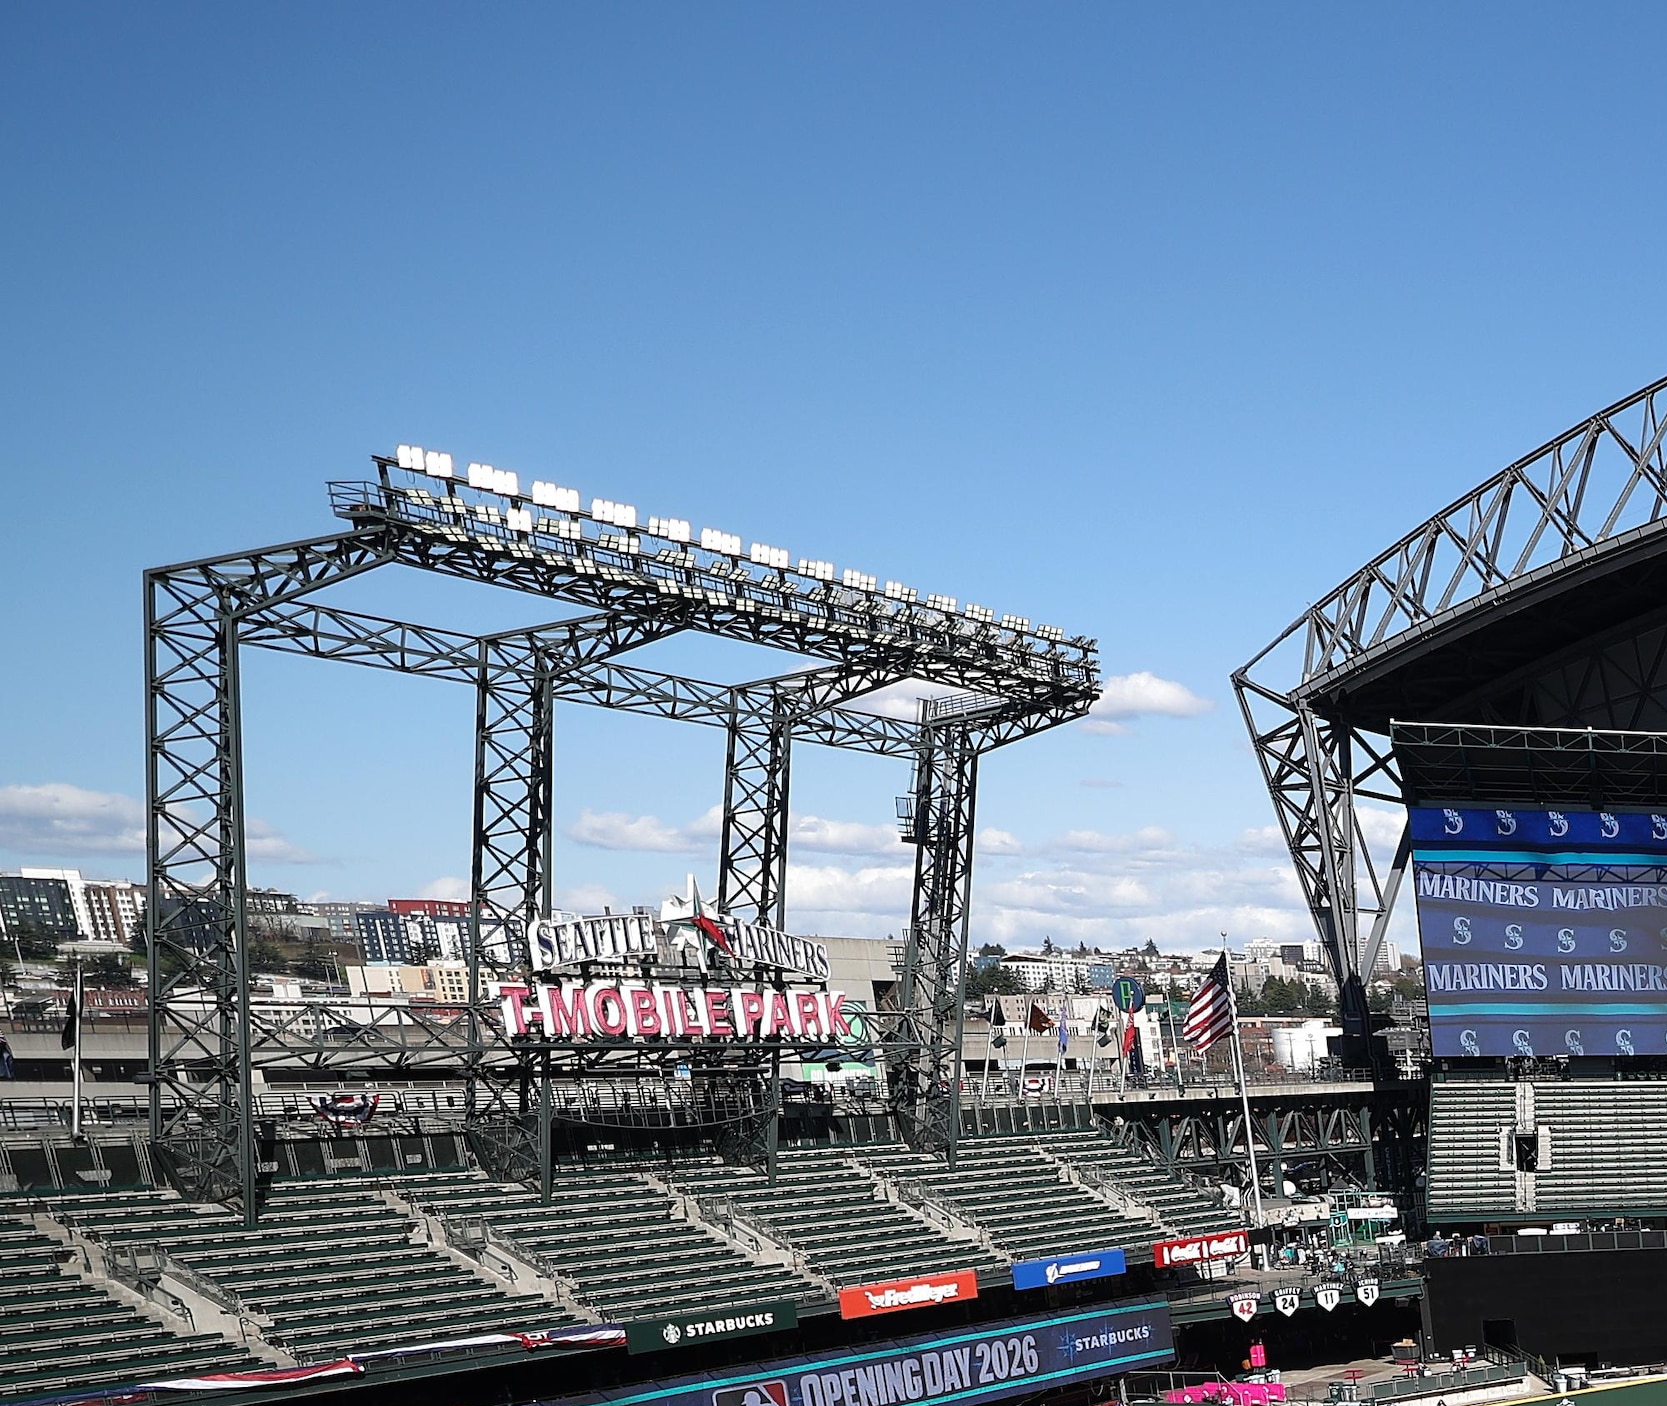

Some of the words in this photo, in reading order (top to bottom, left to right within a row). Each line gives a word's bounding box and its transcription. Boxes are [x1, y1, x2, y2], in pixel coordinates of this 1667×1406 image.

[1418, 872, 1539, 908] MARINERS
[538, 916, 655, 969] SEATTLE
[1428, 963, 1548, 992] MARINERS
[499, 985, 734, 1037] T-MOBILE
[742, 985, 852, 1037] PARK
[1281, 1297, 1295, 1310] 24
[1324, 1292, 1334, 1304] 11
[1363, 1287, 1375, 1299] 51
[1239, 1302, 1253, 1315] 42
[685, 1312, 774, 1337] STARBUCKS
[921, 1347, 973, 1398] DAY
[976, 1334, 1039, 1384] 2026
[1075, 1326, 1150, 1352] STARBUCKS
